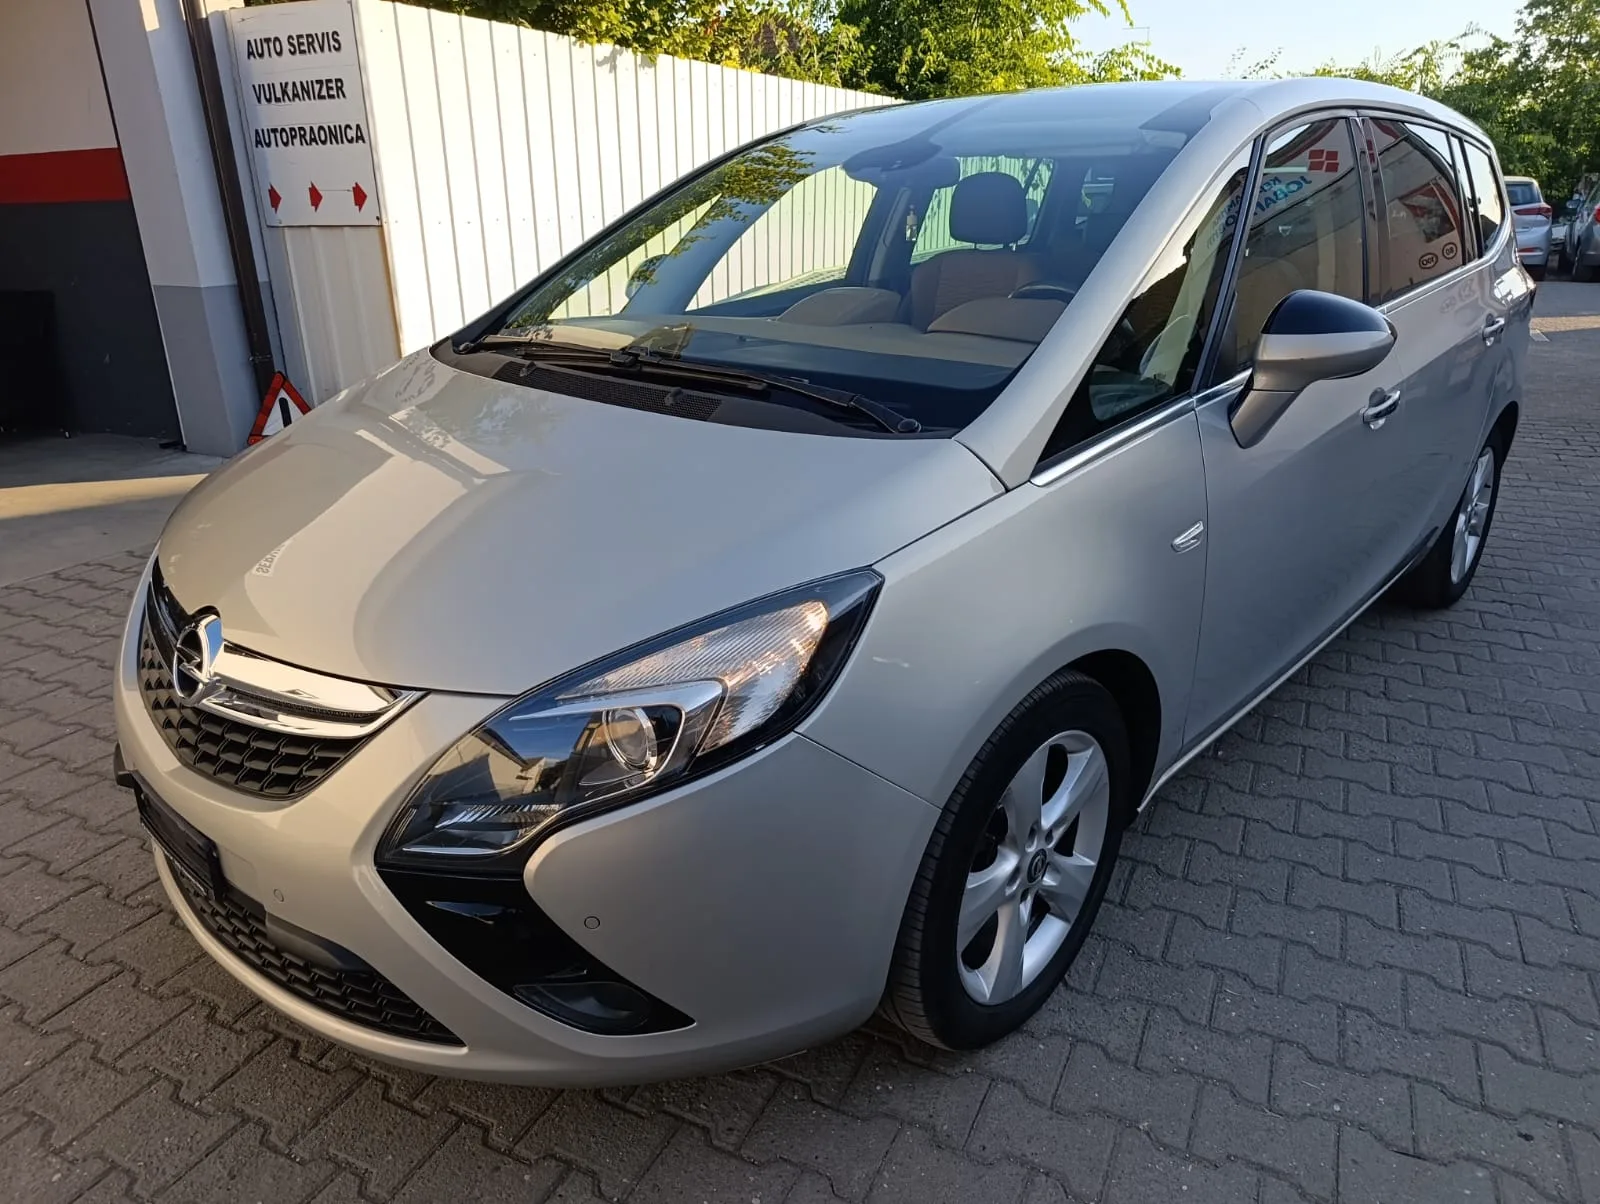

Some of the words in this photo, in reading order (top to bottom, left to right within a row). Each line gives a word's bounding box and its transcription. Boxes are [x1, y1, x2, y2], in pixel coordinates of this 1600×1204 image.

[247, 36, 283, 60] AUTO
[287, 30, 342, 56] SERVIS
[252, 78, 346, 105] VULKANIZER
[254, 123, 366, 149] AUTOPRAONICA
